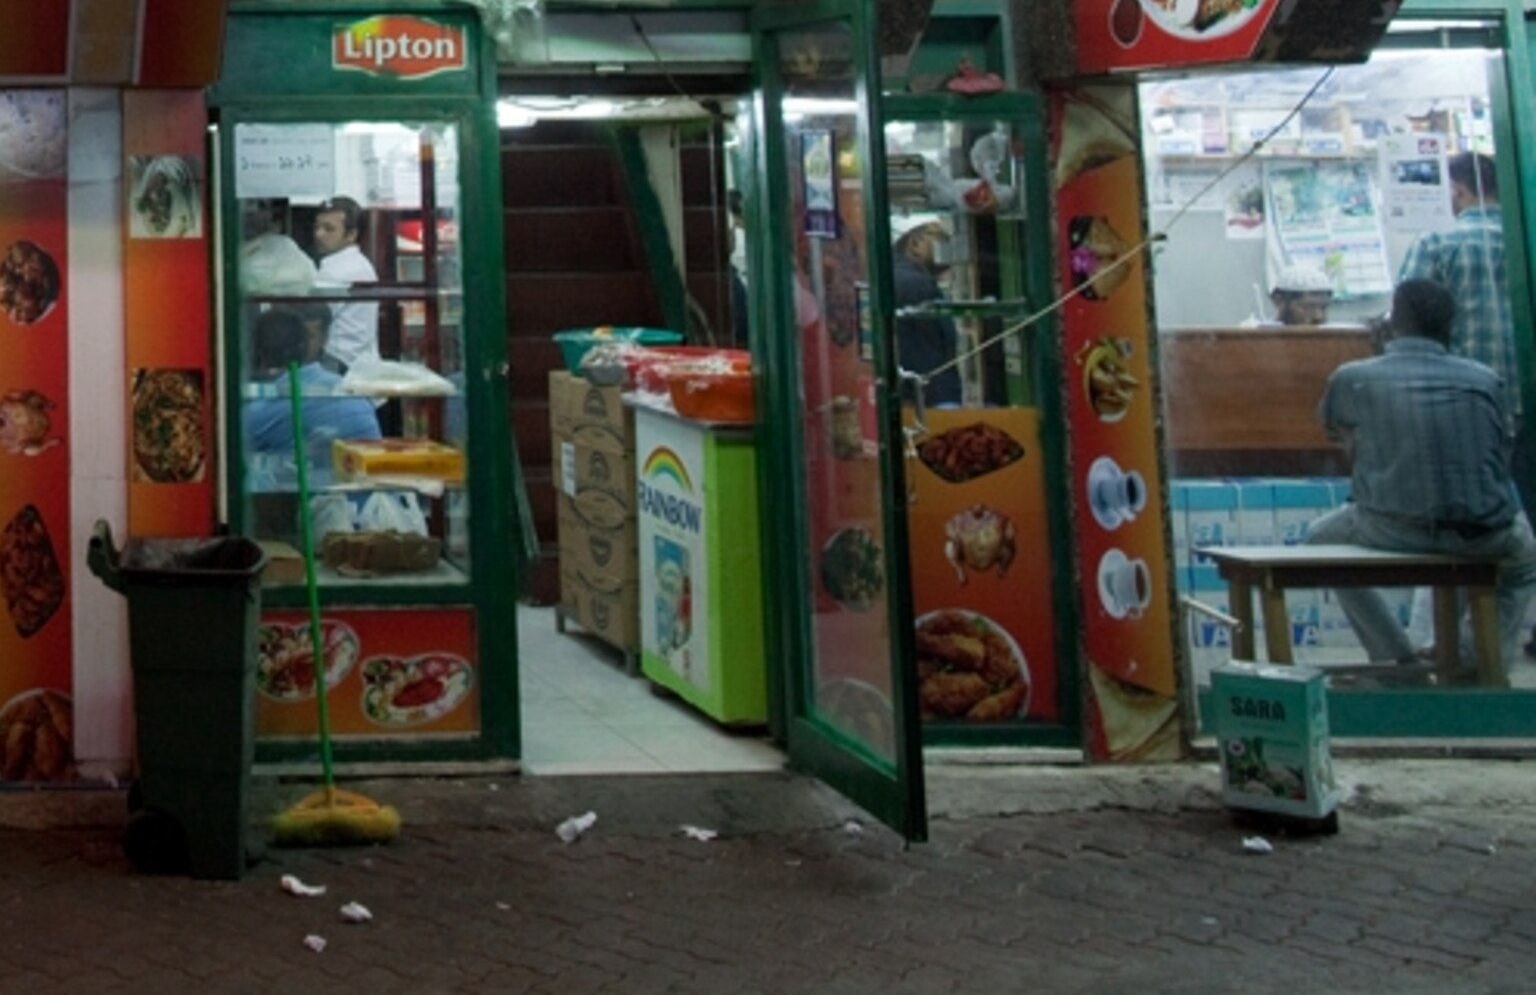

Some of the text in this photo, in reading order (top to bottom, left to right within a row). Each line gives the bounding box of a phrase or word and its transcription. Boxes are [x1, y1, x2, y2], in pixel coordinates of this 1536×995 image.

[343, 31, 456, 67] Lipton
[637, 478, 702, 534] RAINBOW
[1229, 696, 1286, 721] SARA
